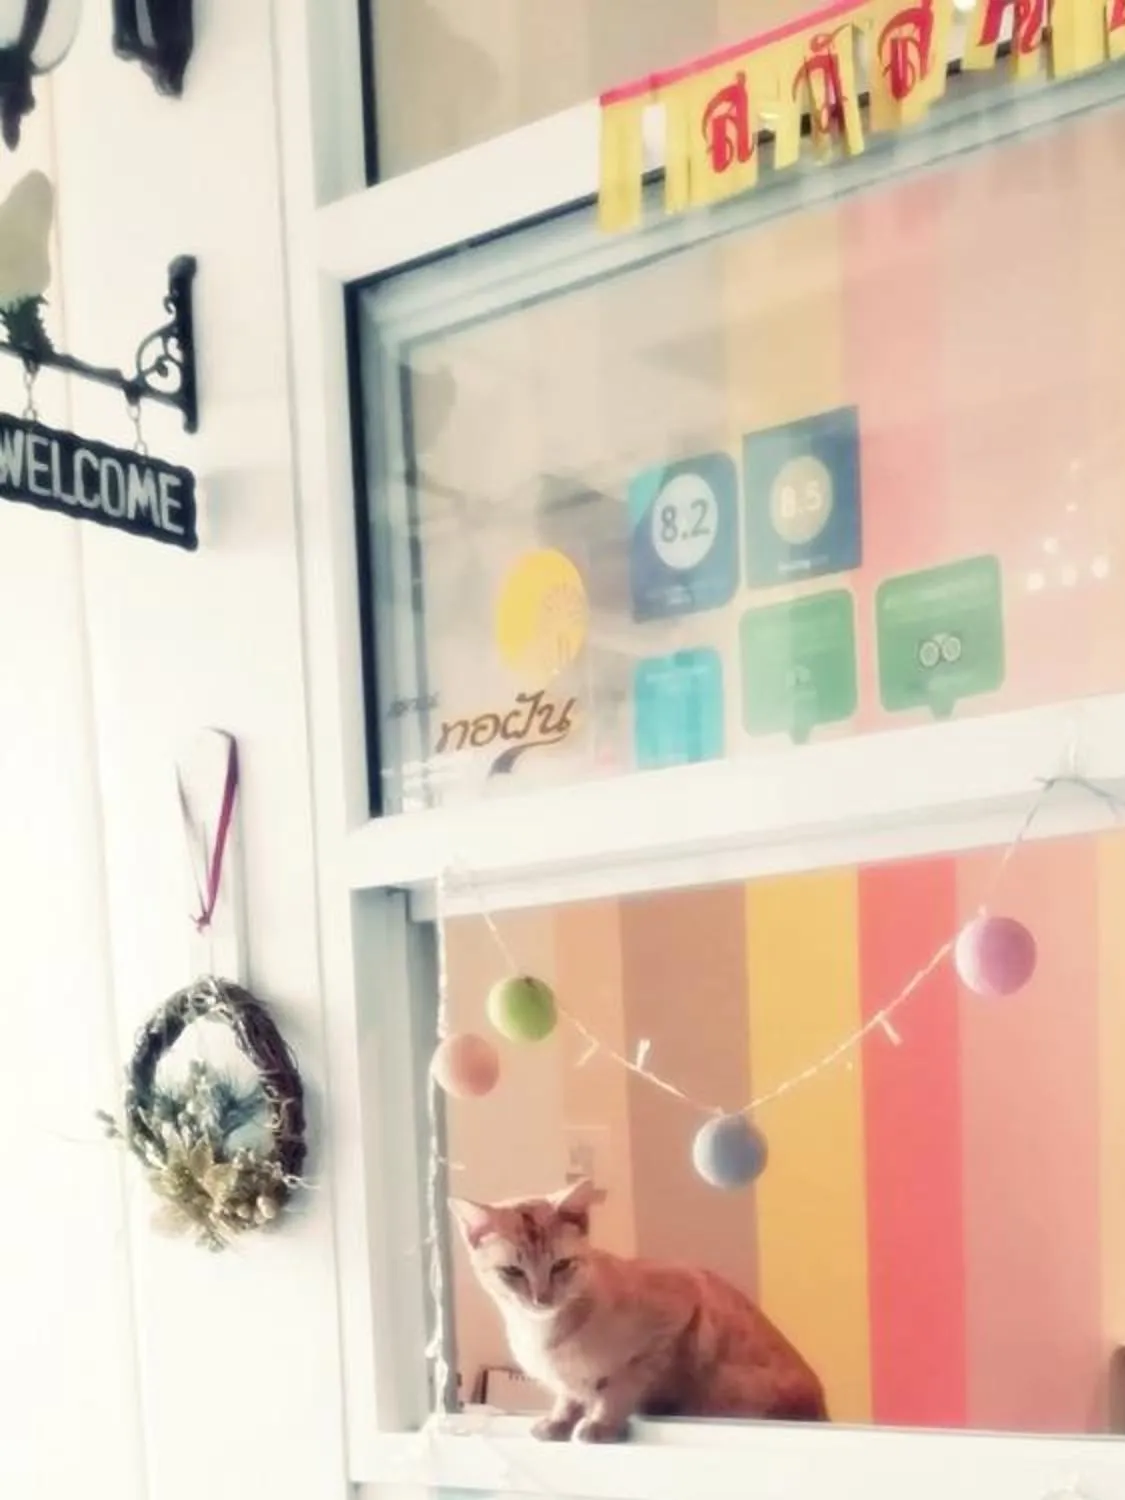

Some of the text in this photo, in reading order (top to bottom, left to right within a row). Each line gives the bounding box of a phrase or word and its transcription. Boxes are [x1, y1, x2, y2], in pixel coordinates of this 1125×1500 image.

[0, 428, 185, 535] WELCOME
[659, 499, 712, 542] 8.2
[434, 690, 578, 760] ทอฝัน
